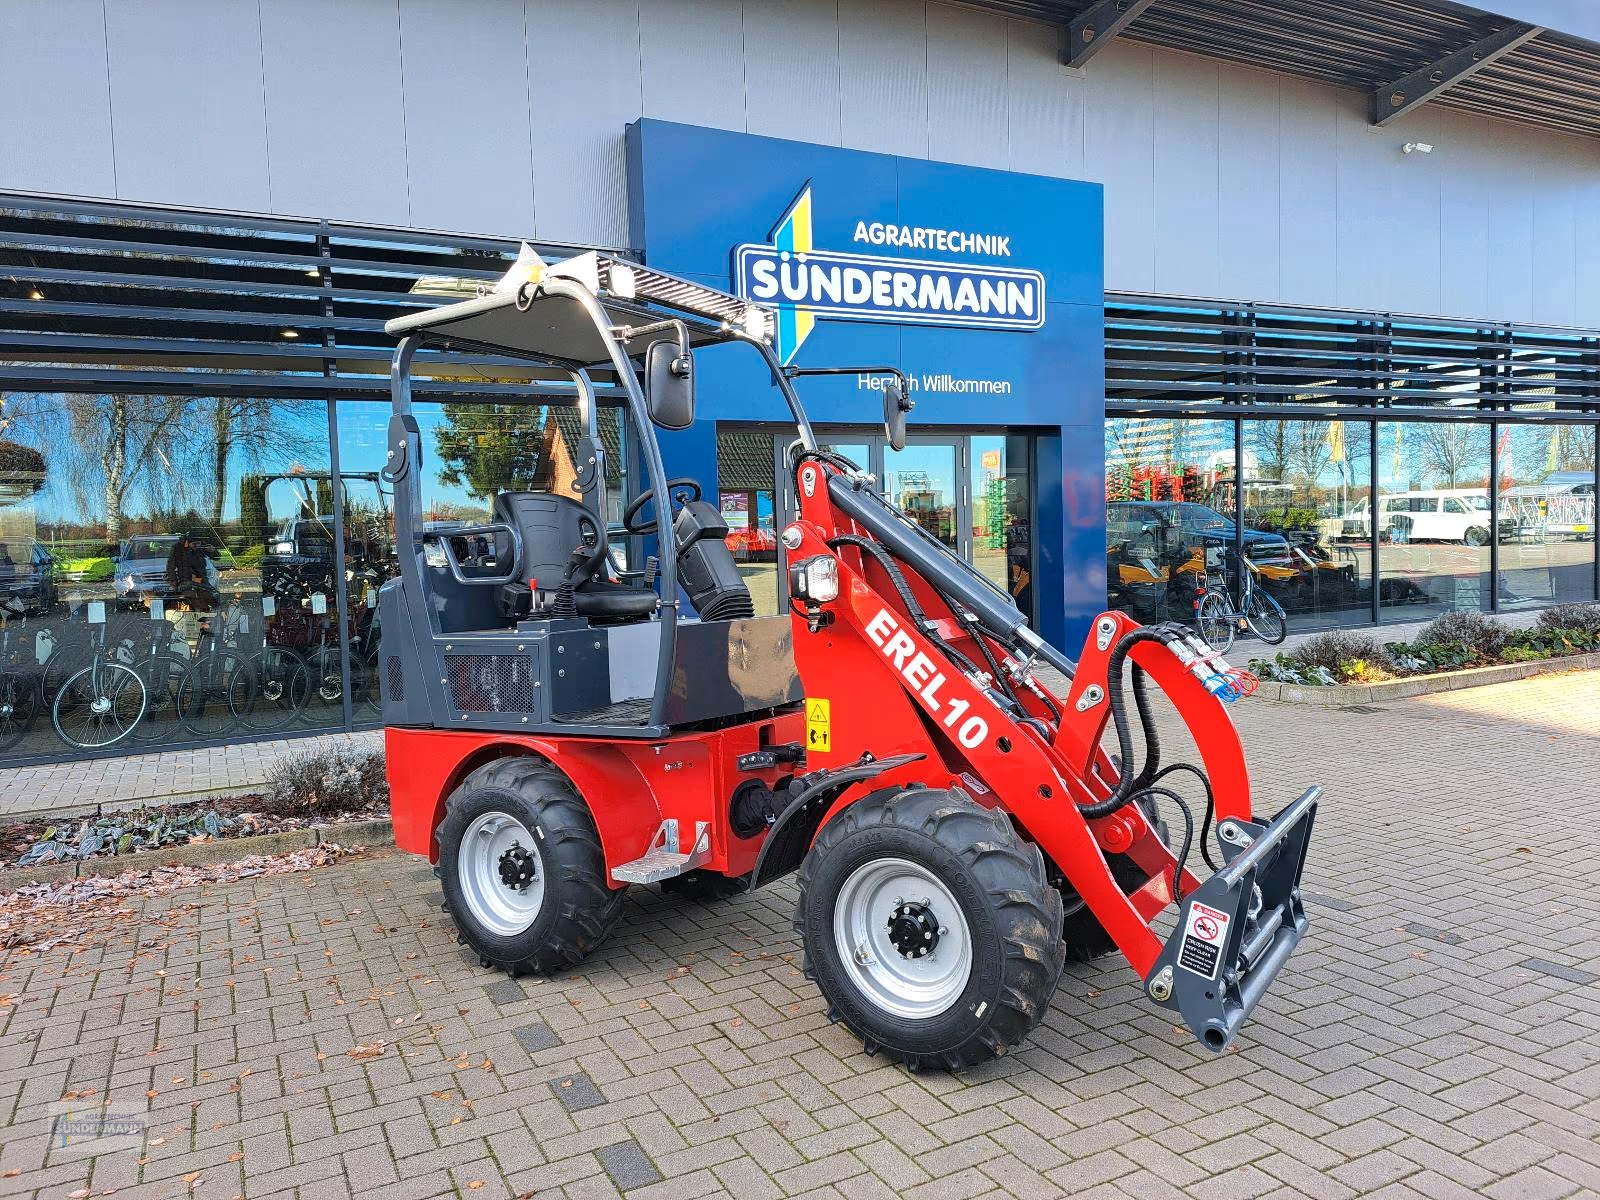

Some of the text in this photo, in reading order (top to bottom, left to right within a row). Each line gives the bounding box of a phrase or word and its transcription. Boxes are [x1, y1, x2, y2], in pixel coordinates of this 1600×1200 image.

[853, 221, 1011, 257] AGRARTECHNIK
[752, 251, 1034, 317] SÜNDERMANN
[858, 373, 1011, 394] Herzlh Willkommen
[865, 608, 989, 749] EREL 10
